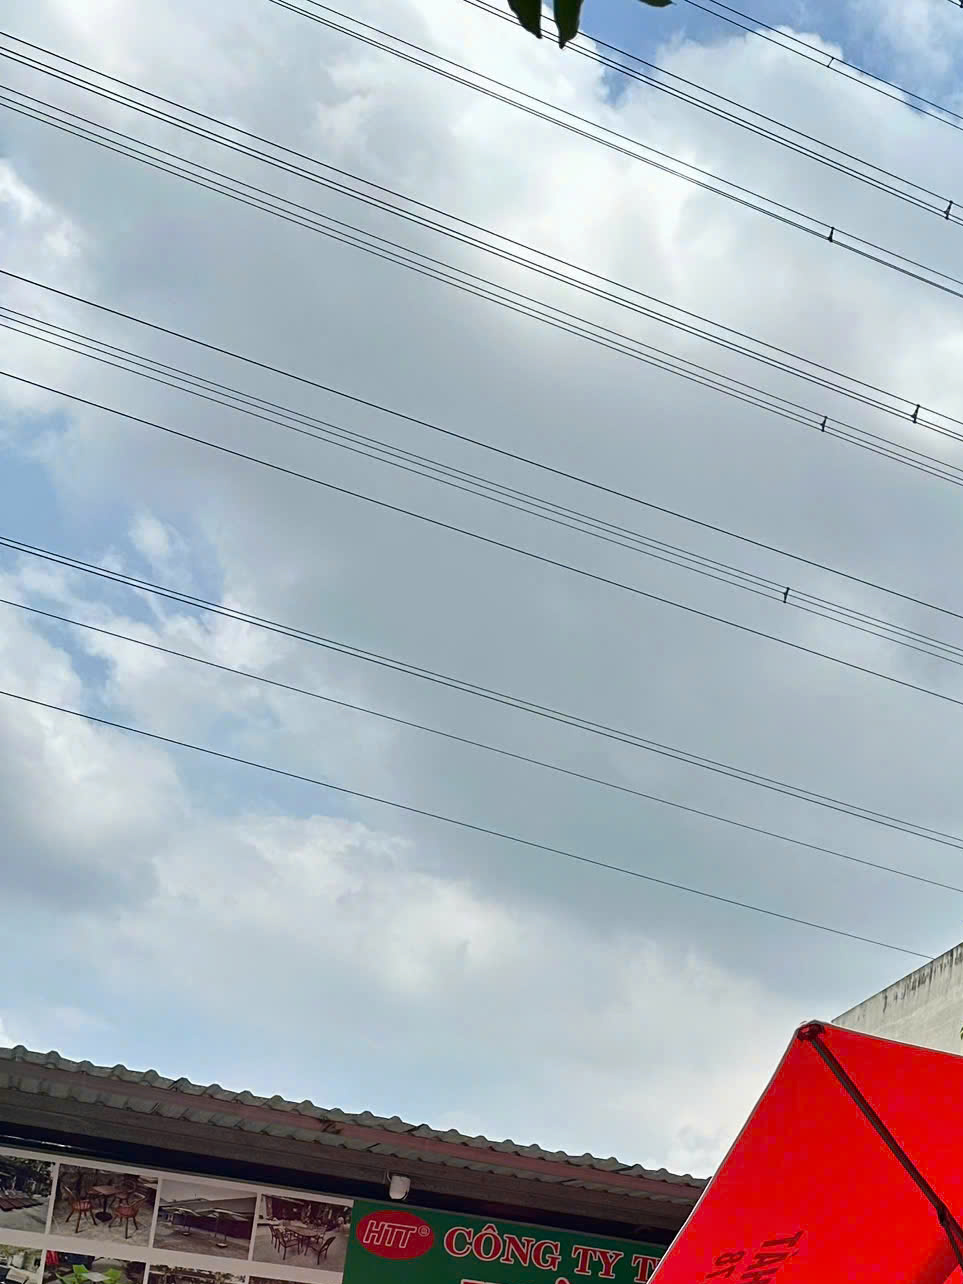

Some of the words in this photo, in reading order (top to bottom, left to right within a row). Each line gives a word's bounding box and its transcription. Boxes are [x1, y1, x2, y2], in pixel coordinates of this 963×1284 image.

[363, 1220, 418, 1249] HTT
[444, 1224, 562, 1272] CÔNG
[571, 1245, 625, 1279] TY
